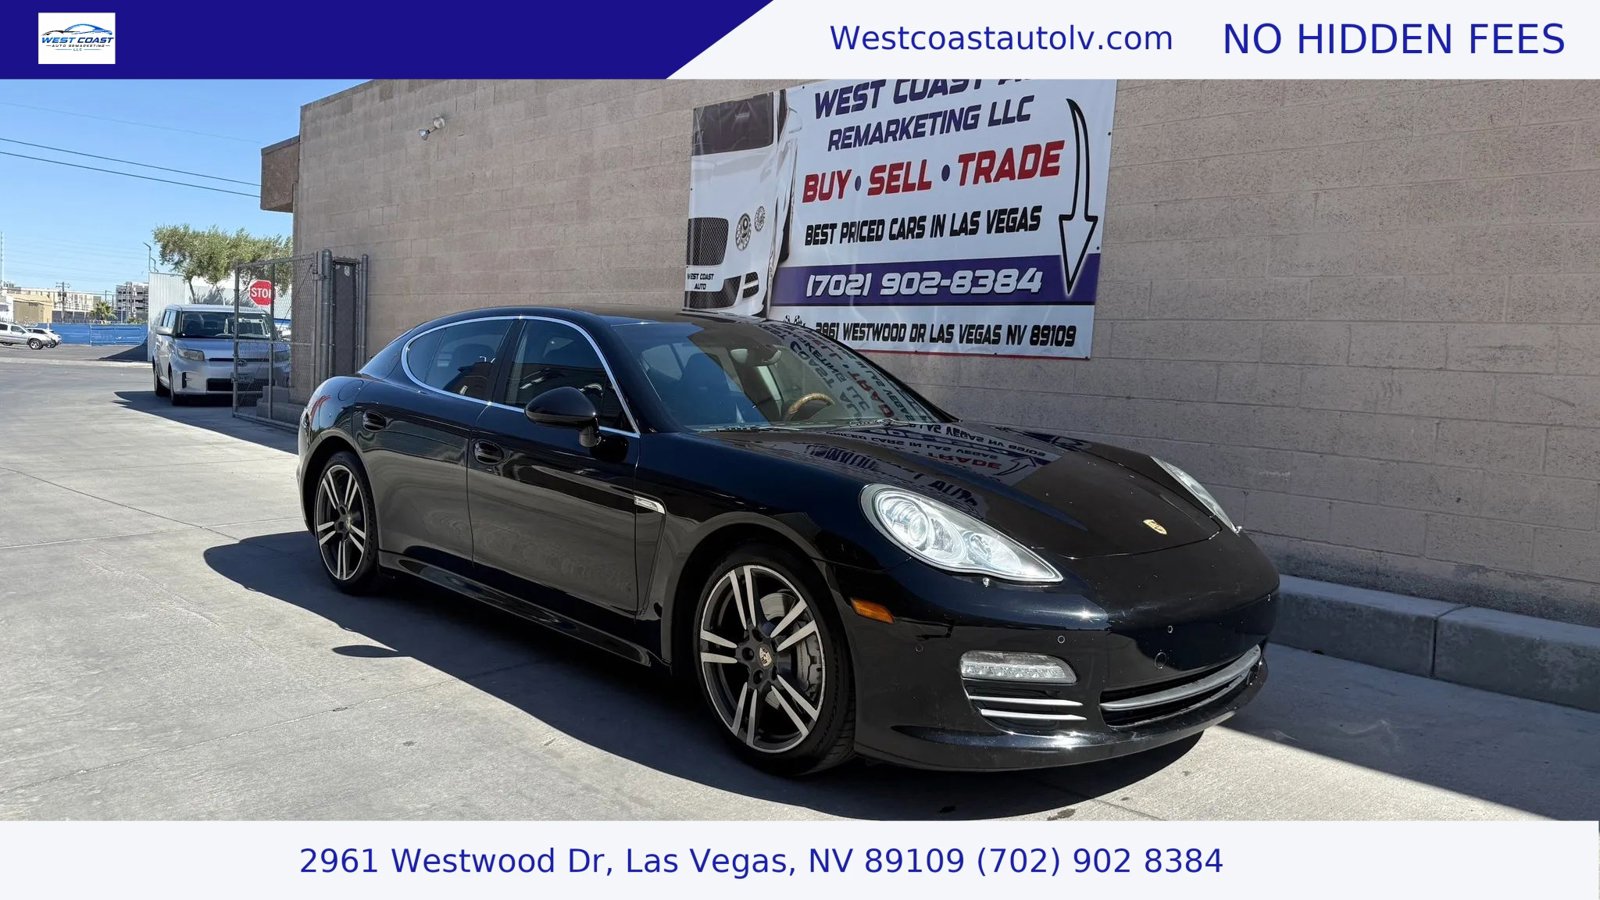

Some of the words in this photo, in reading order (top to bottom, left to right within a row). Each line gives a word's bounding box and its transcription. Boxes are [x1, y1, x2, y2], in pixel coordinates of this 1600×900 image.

[815, 79, 886, 119] WEST
[828, 105, 982, 152] REMARKETING
[987, 95, 1035, 127] LLC
[802, 169, 852, 203] BUY
[867, 159, 932, 196] SELL
[958, 140, 1065, 186] TRADE
[805, 223, 838, 246] BEST
[839, 219, 885, 244] PRICED
[888, 215, 927, 240] CARS
[929, 213, 946, 238] IN
[949, 210, 981, 237] LAS
[986, 205, 1043, 235] VEGAS
[700, 273, 714, 281] COAST
[880, 267, 1043, 295] 902-8384
[843, 322, 907, 342] WESTWOOD
[909, 323, 927, 343] DR
[929, 323, 955, 344] LAS
[958, 323, 1003, 345] VEGAS
[1005, 324, 1028, 346] NV
[1029, 324, 1077, 348] 89109
